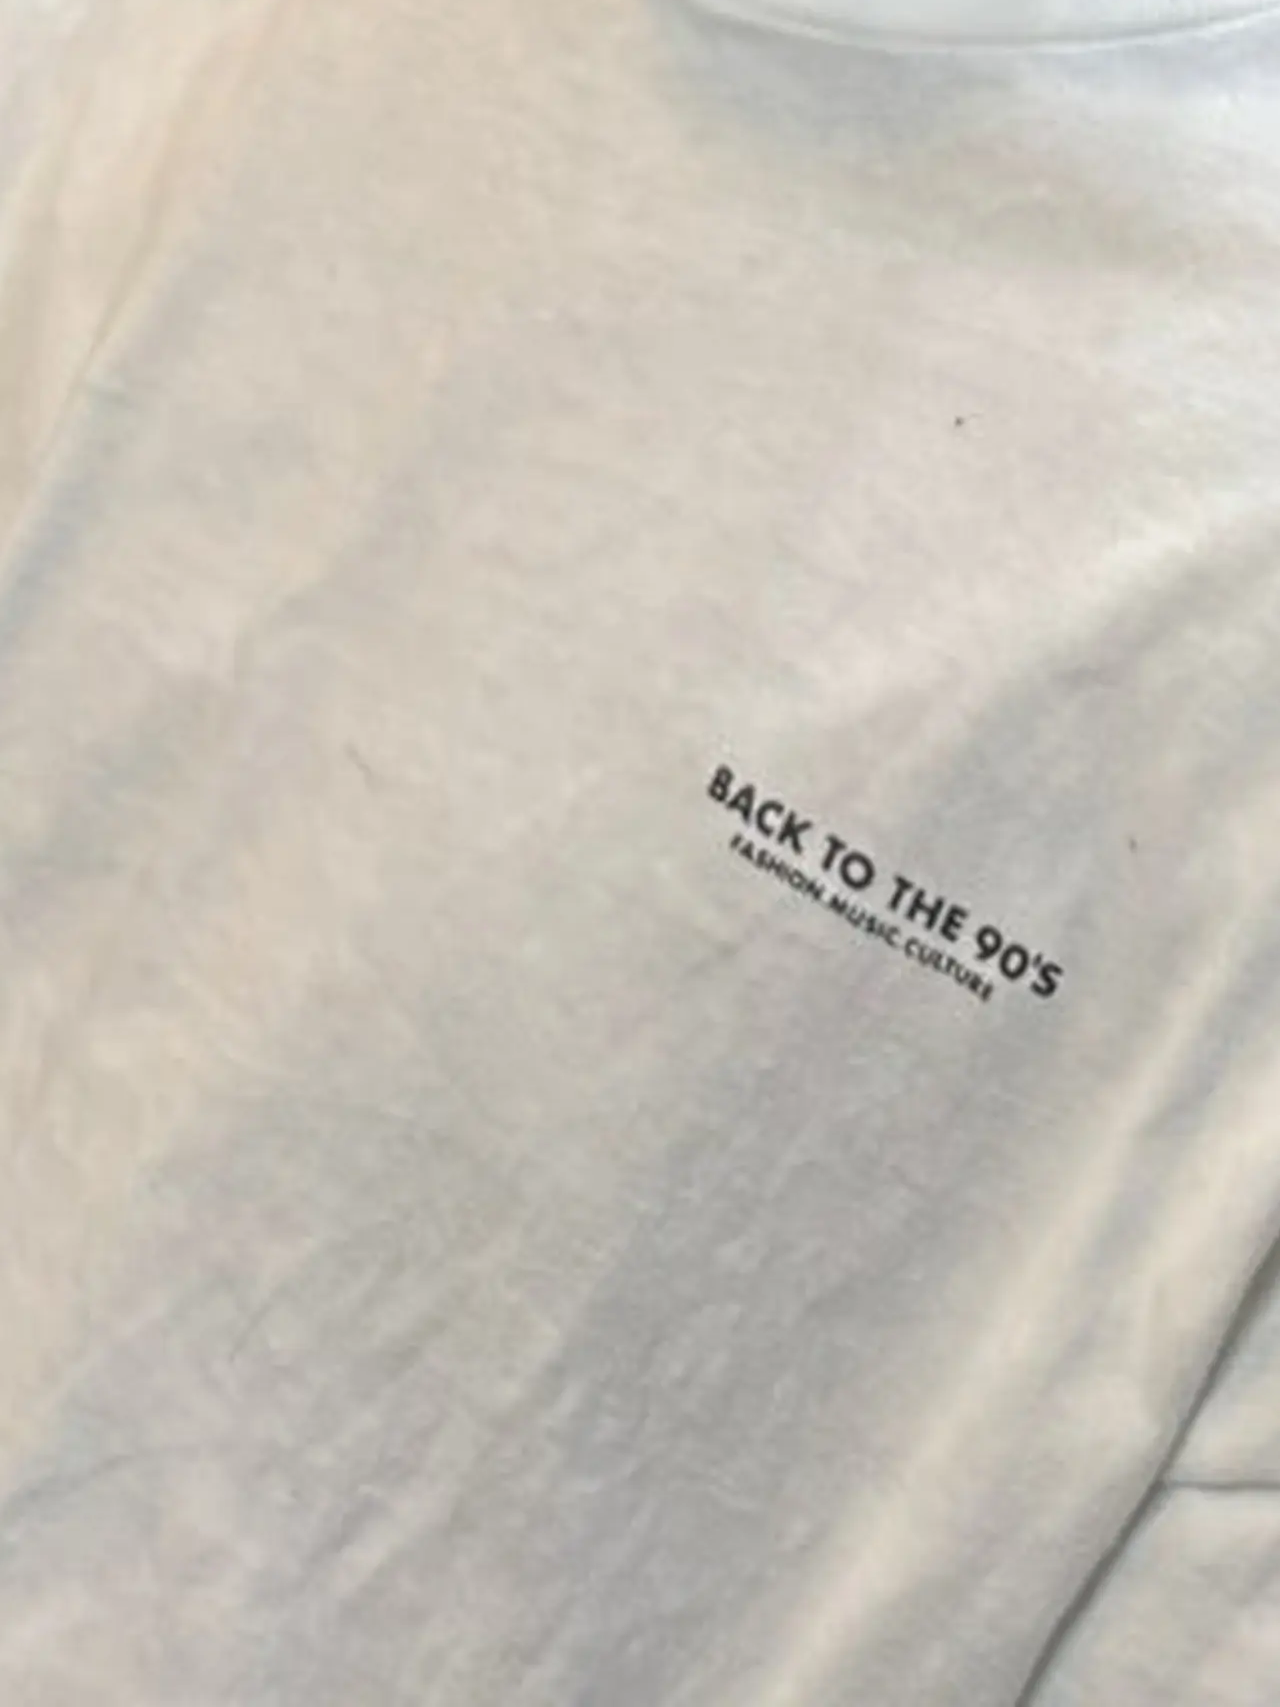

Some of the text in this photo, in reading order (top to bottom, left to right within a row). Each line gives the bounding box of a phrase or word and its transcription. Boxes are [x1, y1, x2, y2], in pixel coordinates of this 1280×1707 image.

[707, 764, 1064, 999] BACK TO THE 90'S
